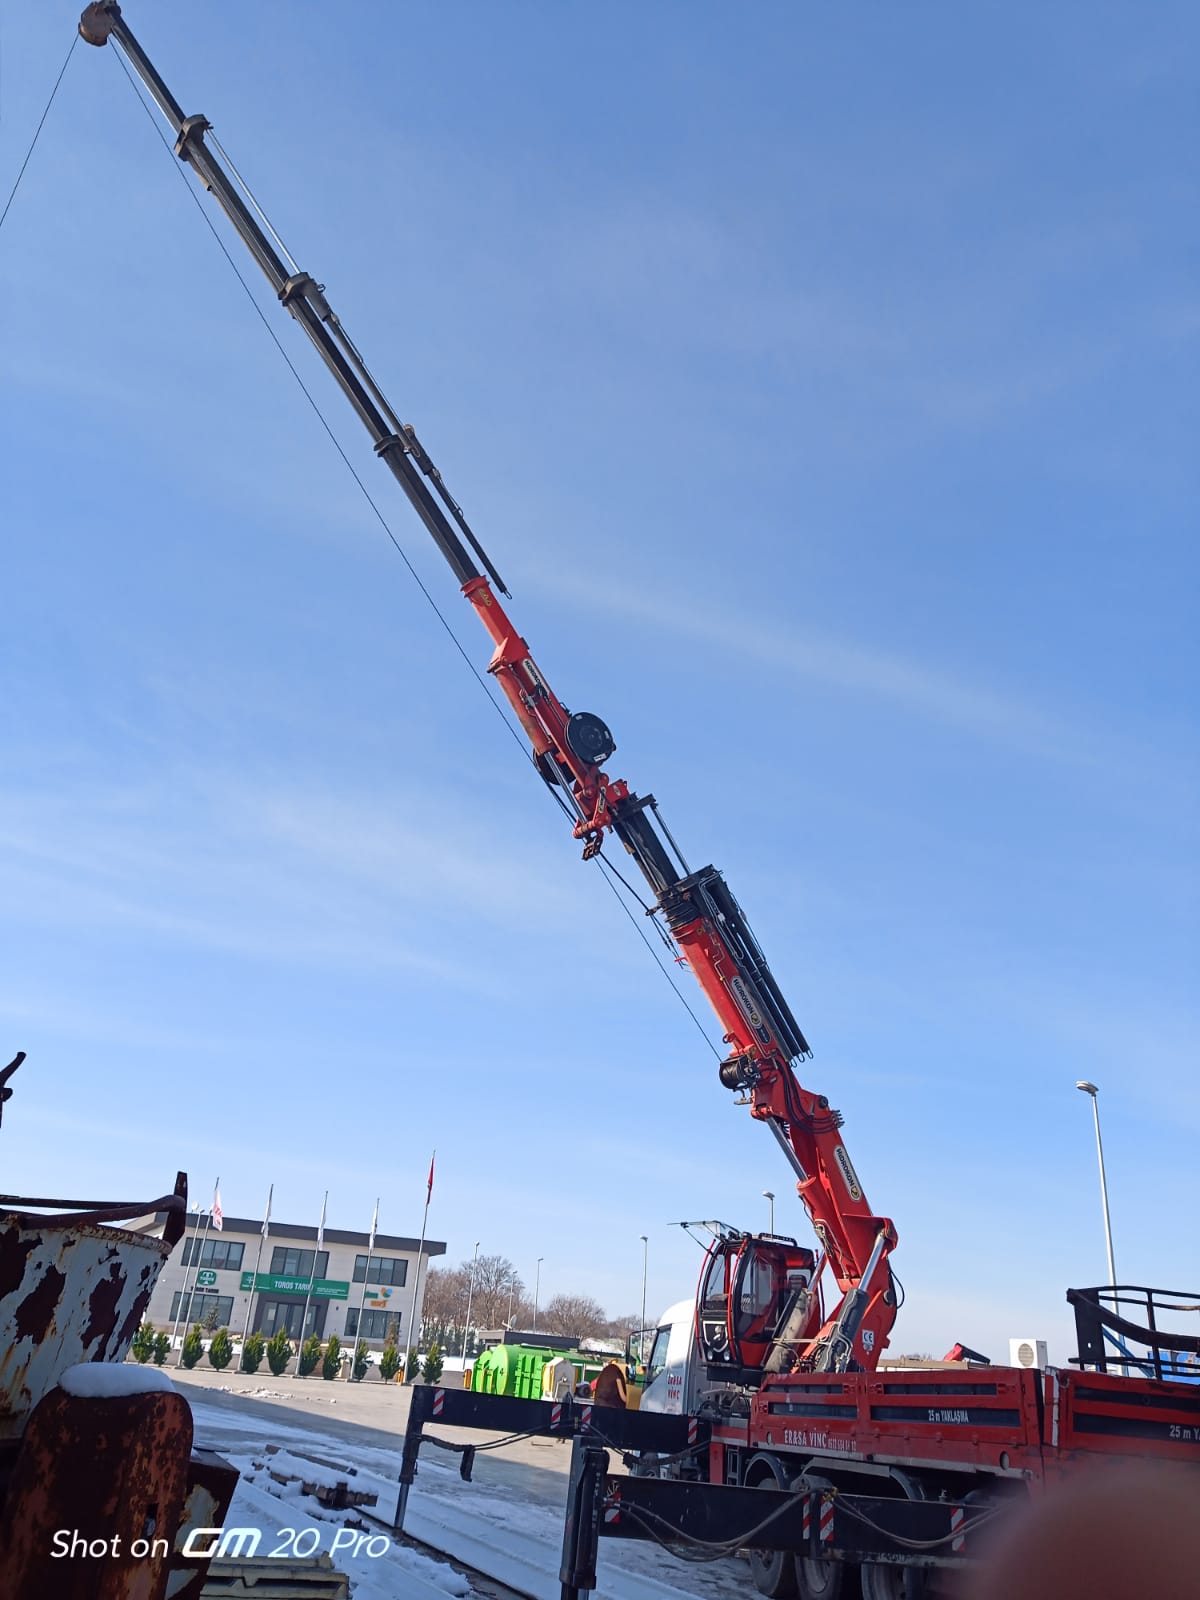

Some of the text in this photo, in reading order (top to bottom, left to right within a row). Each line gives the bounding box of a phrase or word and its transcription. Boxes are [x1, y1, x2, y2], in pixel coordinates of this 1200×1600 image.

[275, 1280, 293, 1290] TOROS
[784, 1429, 807, 1447] ER&SA
[1169, 1424, 1200, 1441] 25 m Y
